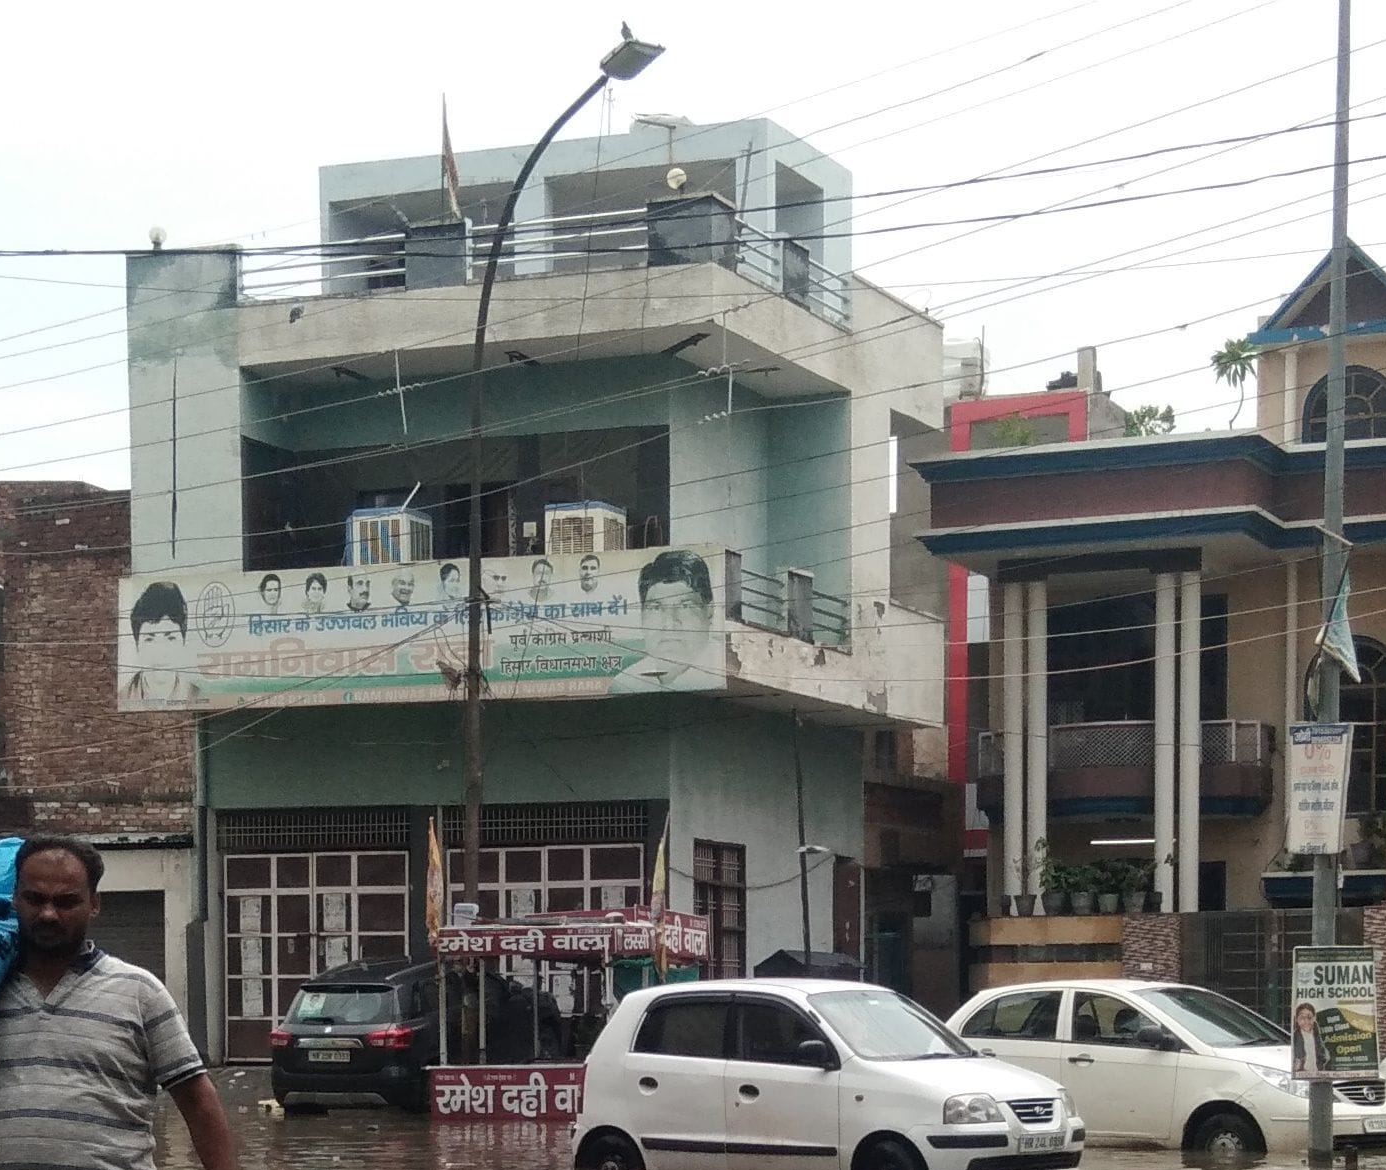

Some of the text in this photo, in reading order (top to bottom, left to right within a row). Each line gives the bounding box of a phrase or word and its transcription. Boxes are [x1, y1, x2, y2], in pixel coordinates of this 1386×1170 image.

[249, 615, 290, 636] हिसार
[295, 614, 310, 633] के
[382, 607, 428, 630] भविष्य
[544, 602, 566, 619] का
[570, 601, 603, 618] साथ
[509, 629, 527, 651] पूर्व
[531, 628, 568, 647] कांग्रेस
[500, 655, 532, 677] हिसार
[535, 653, 597, 674] विधानसभा
[438, 928, 612, 953] रमेश दही वाला
[684, 927, 707, 956] वाला
[1313, 964, 1374, 985] SUMAN
[1296, 986, 1375, 999] HIGH SCHOOL
[1324, 1030, 1373, 1043] Admission
[1336, 1045, 1362, 1056] Open
[435, 1071, 582, 1118] रमेश दही वा
